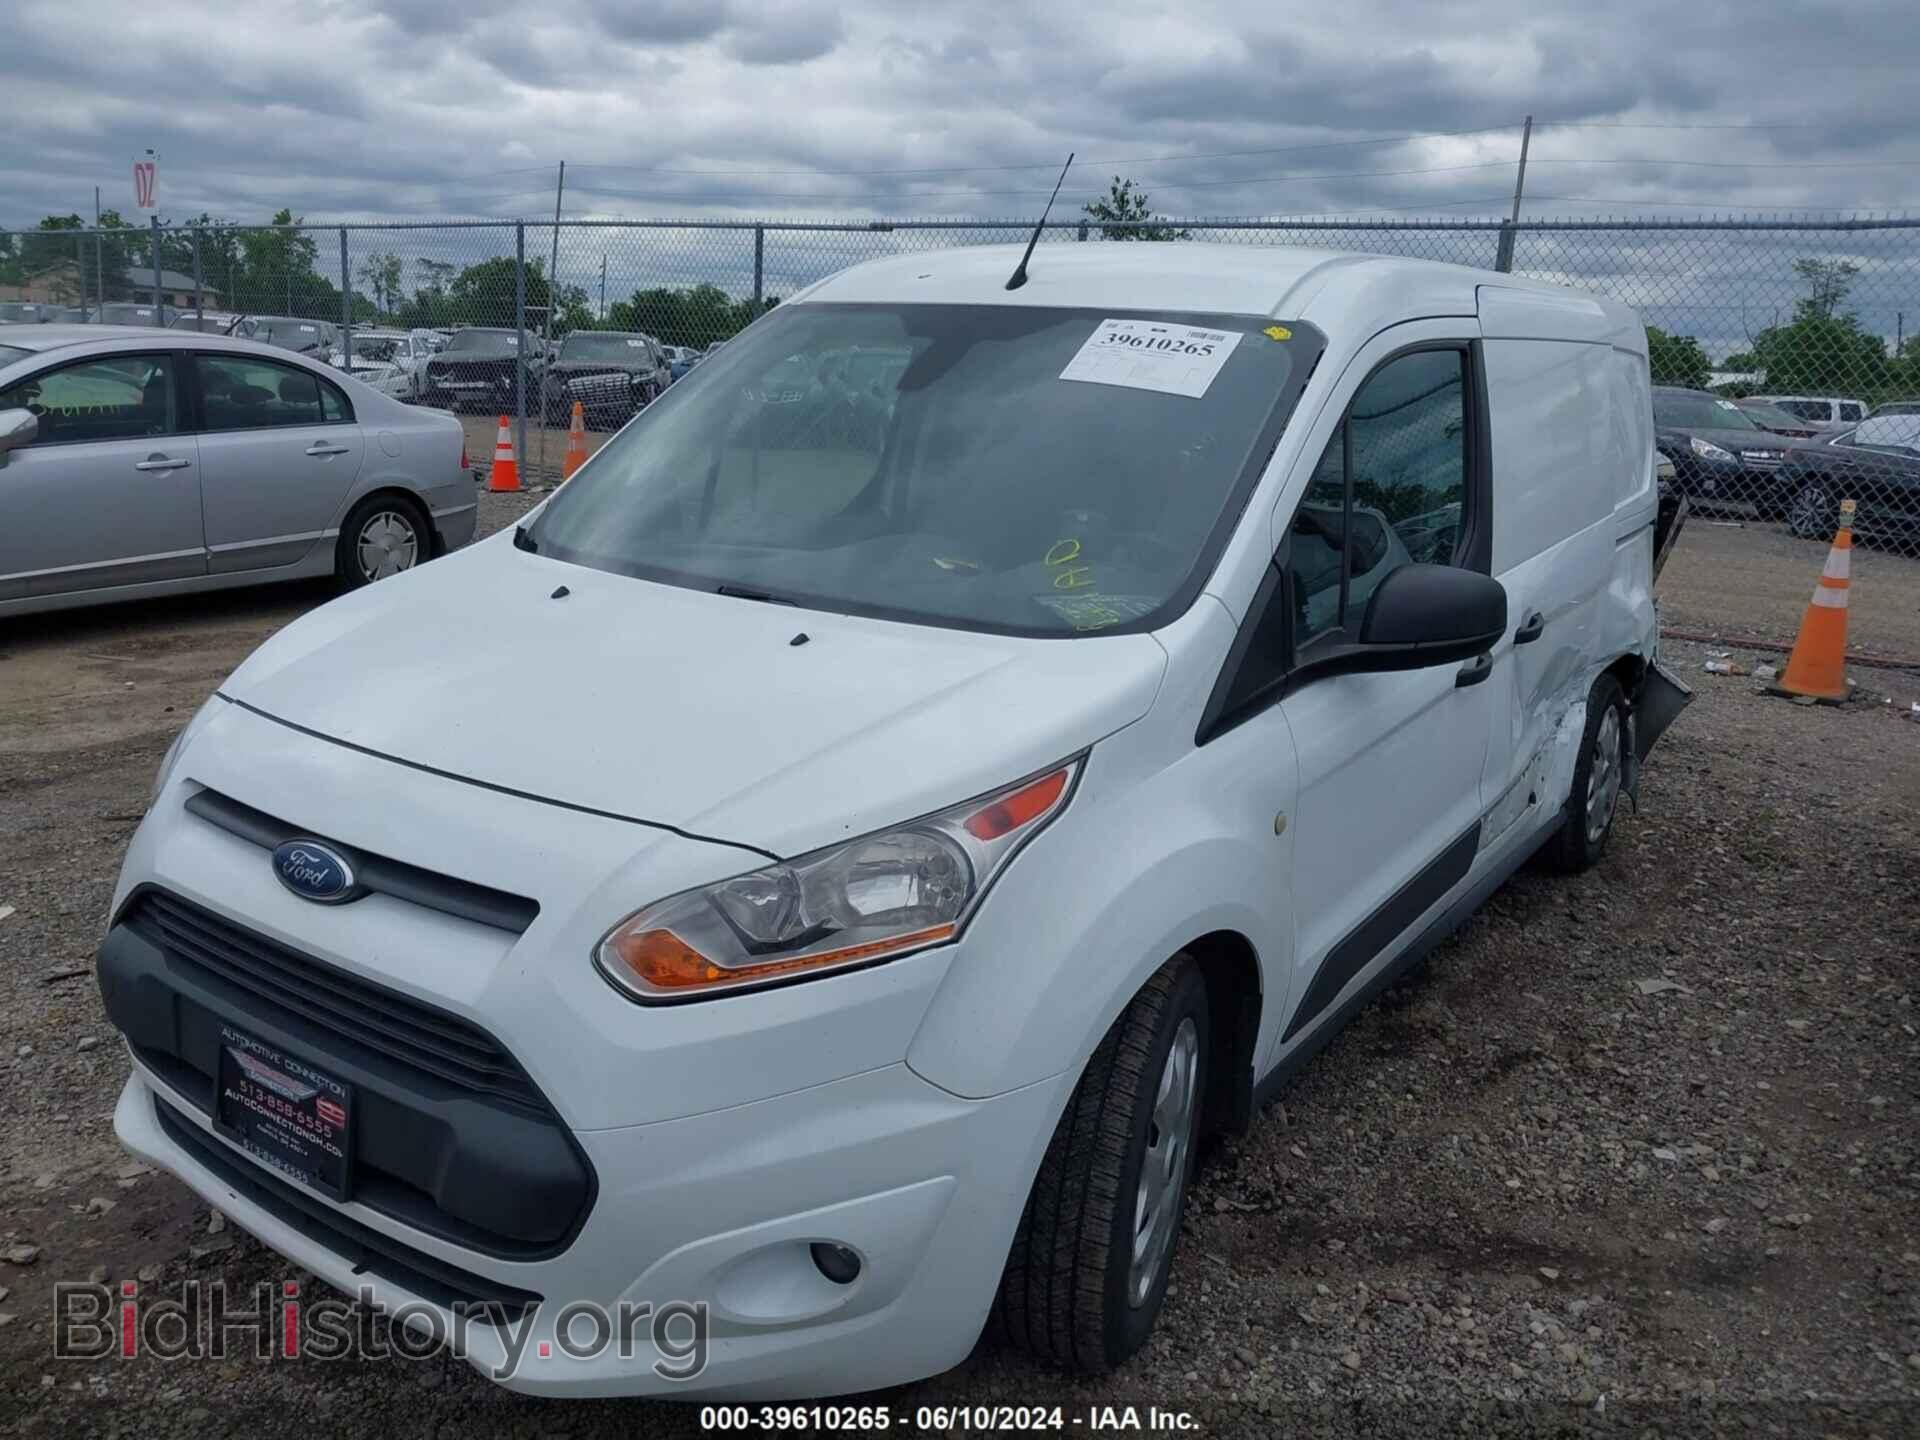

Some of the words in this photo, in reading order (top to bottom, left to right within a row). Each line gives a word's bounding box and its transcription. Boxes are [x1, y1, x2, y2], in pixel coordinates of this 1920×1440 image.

[1101, 333, 1215, 357] 39610265
[282, 849, 330, 886] Ford
[221, 1027, 281, 1065] AUTOMOTIVE
[239, 1080, 333, 1138] 513-858-6555
